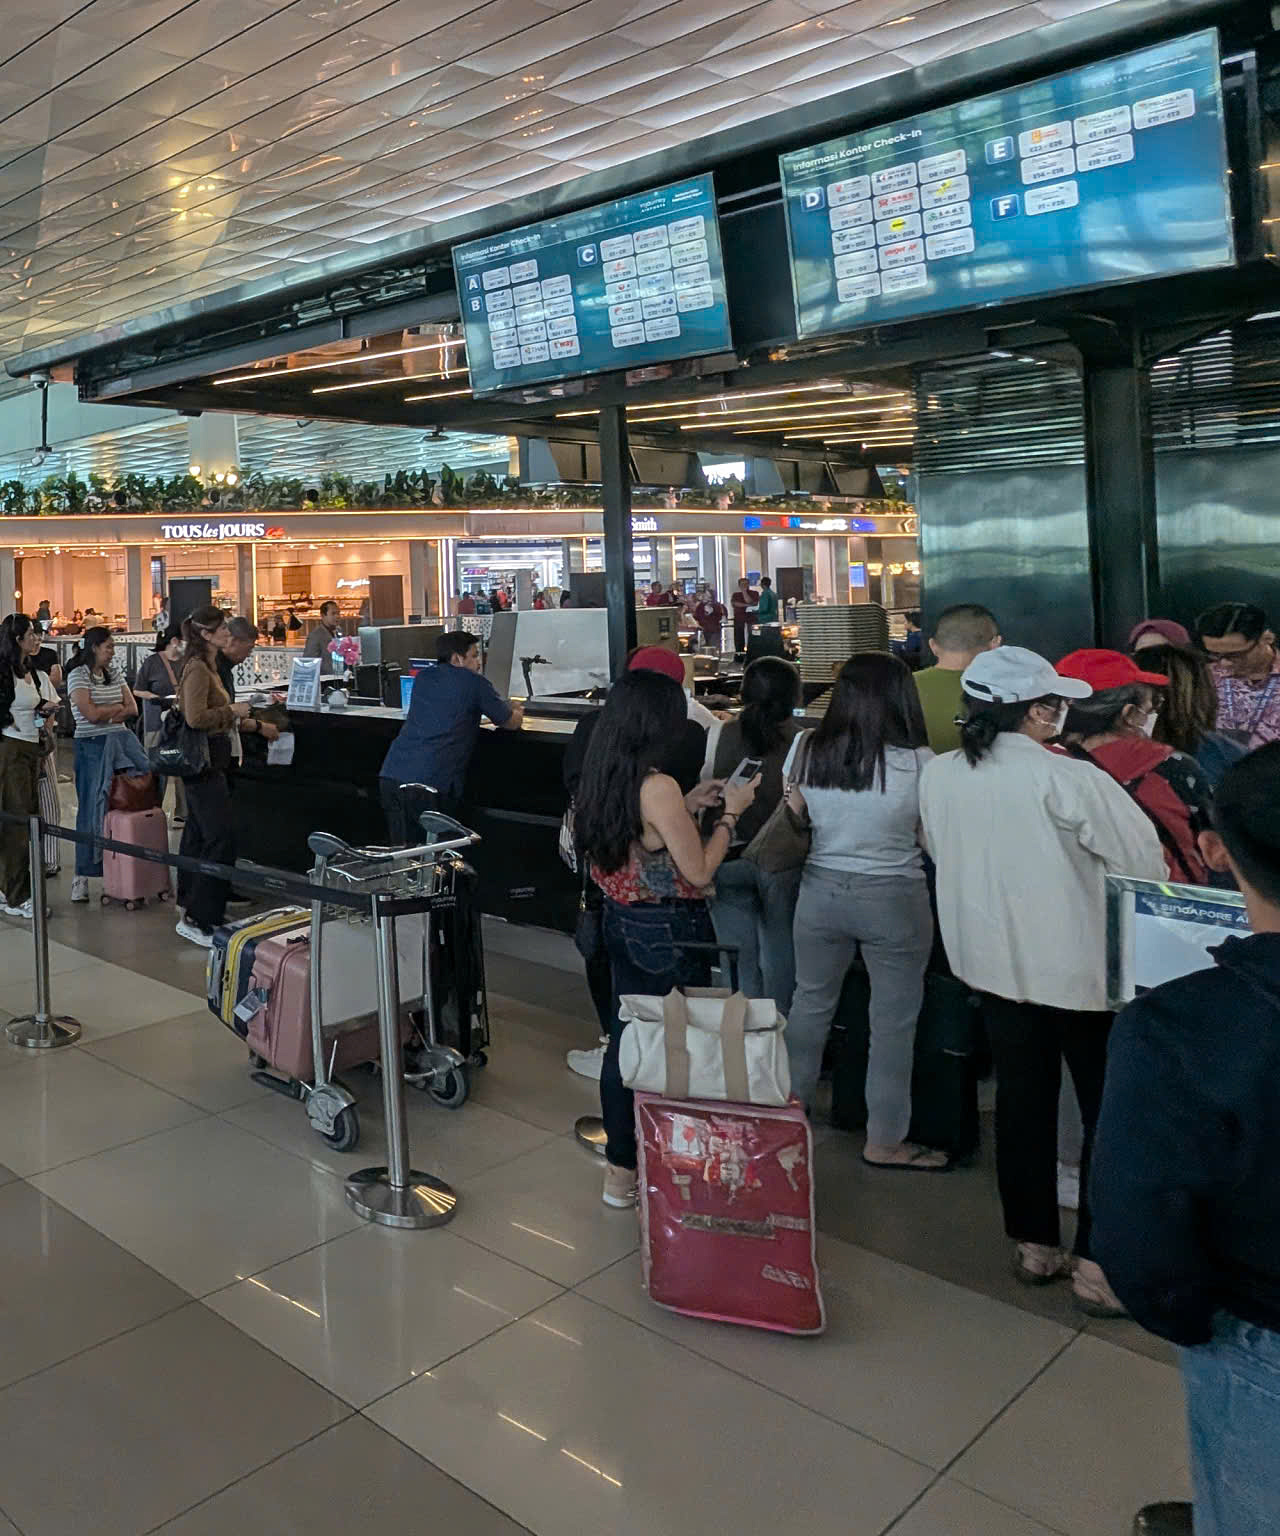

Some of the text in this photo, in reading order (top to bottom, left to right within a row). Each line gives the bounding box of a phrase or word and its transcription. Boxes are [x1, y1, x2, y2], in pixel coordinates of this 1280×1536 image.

[793, 129, 923, 172] Informasi Konter Check-In
[993, 142, 1007, 159] E
[806, 192, 820, 208] D
[998, 199, 1011, 216] F
[581, 249, 595, 262] C
[469, 278, 479, 290] A
[471, 299, 480, 312] B
[161, 524, 202, 539] TOUS
[202, 524, 219, 539] les
[219, 523, 265, 540] JOURS
[1161, 903, 1233, 921] SINGAPORE
